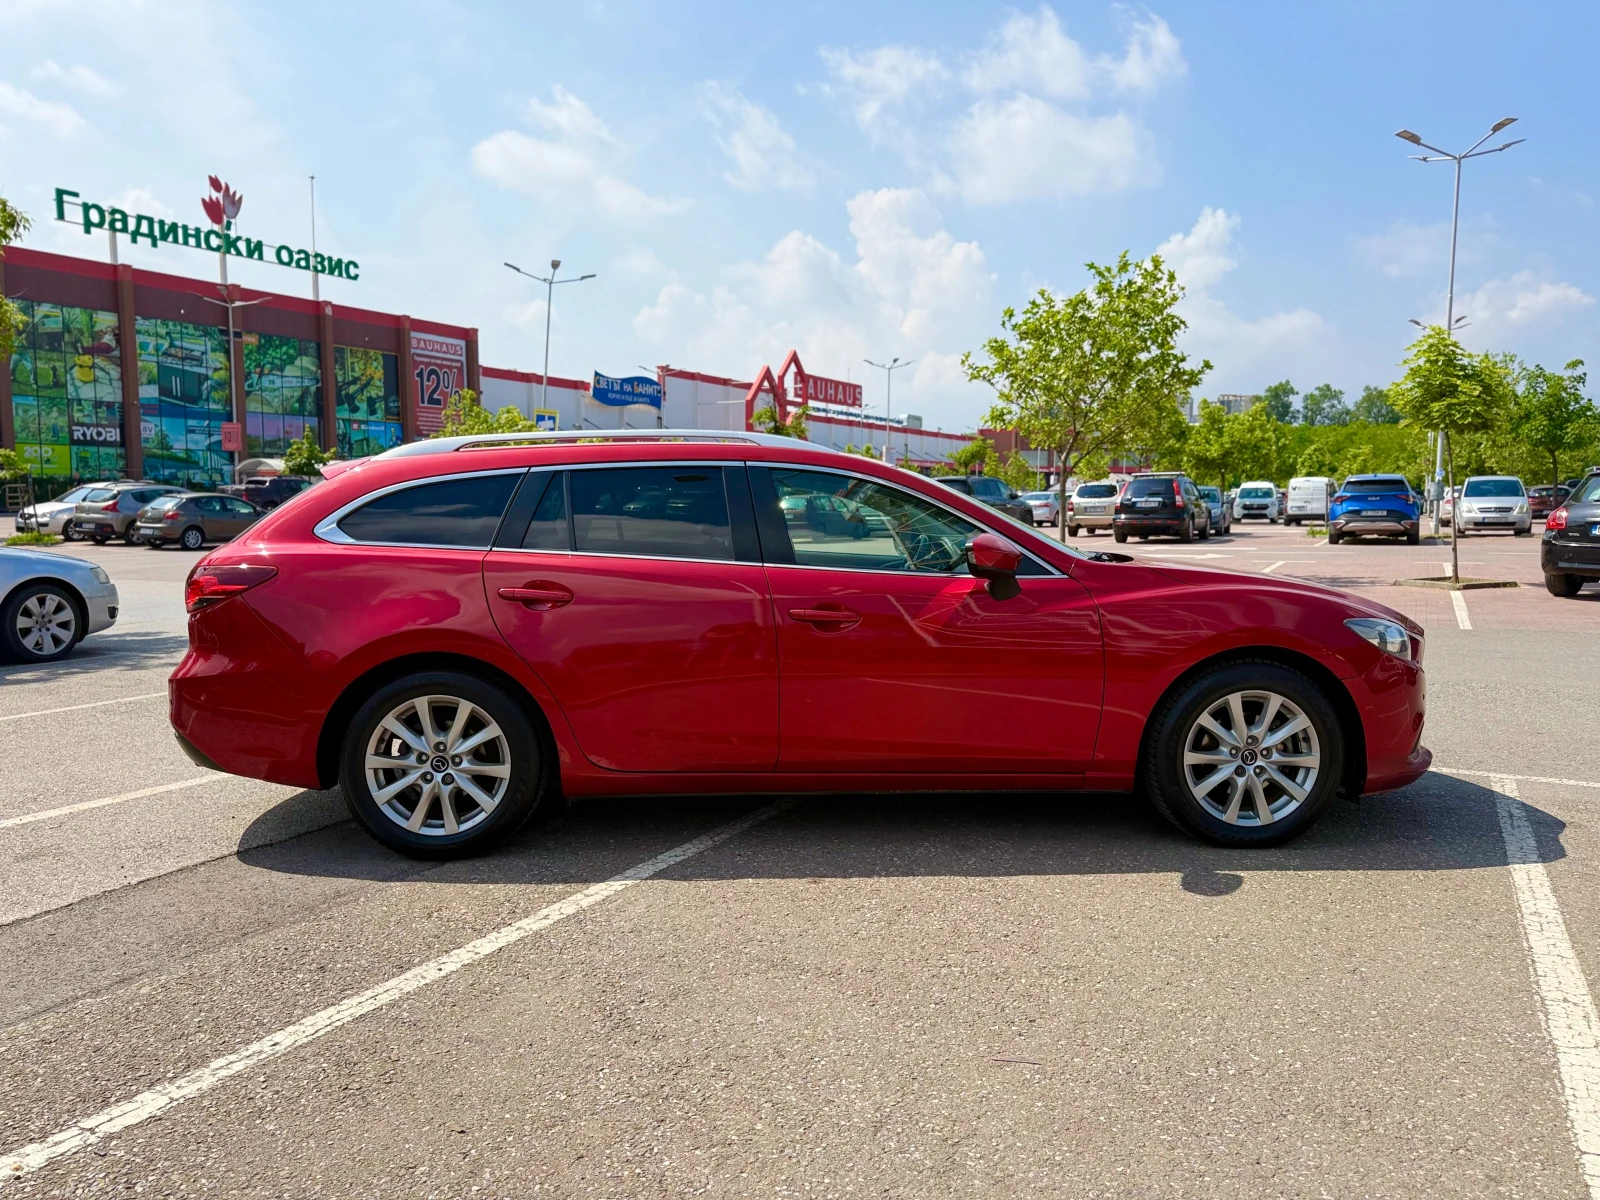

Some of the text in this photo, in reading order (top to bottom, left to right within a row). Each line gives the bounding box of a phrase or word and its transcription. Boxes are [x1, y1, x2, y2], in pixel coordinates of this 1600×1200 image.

[55, 187, 360, 281] Градински оазис
[411, 338, 462, 355] BAUHAUS
[415, 365, 462, 409] 12%
[72, 426, 121, 442] RYOBI
